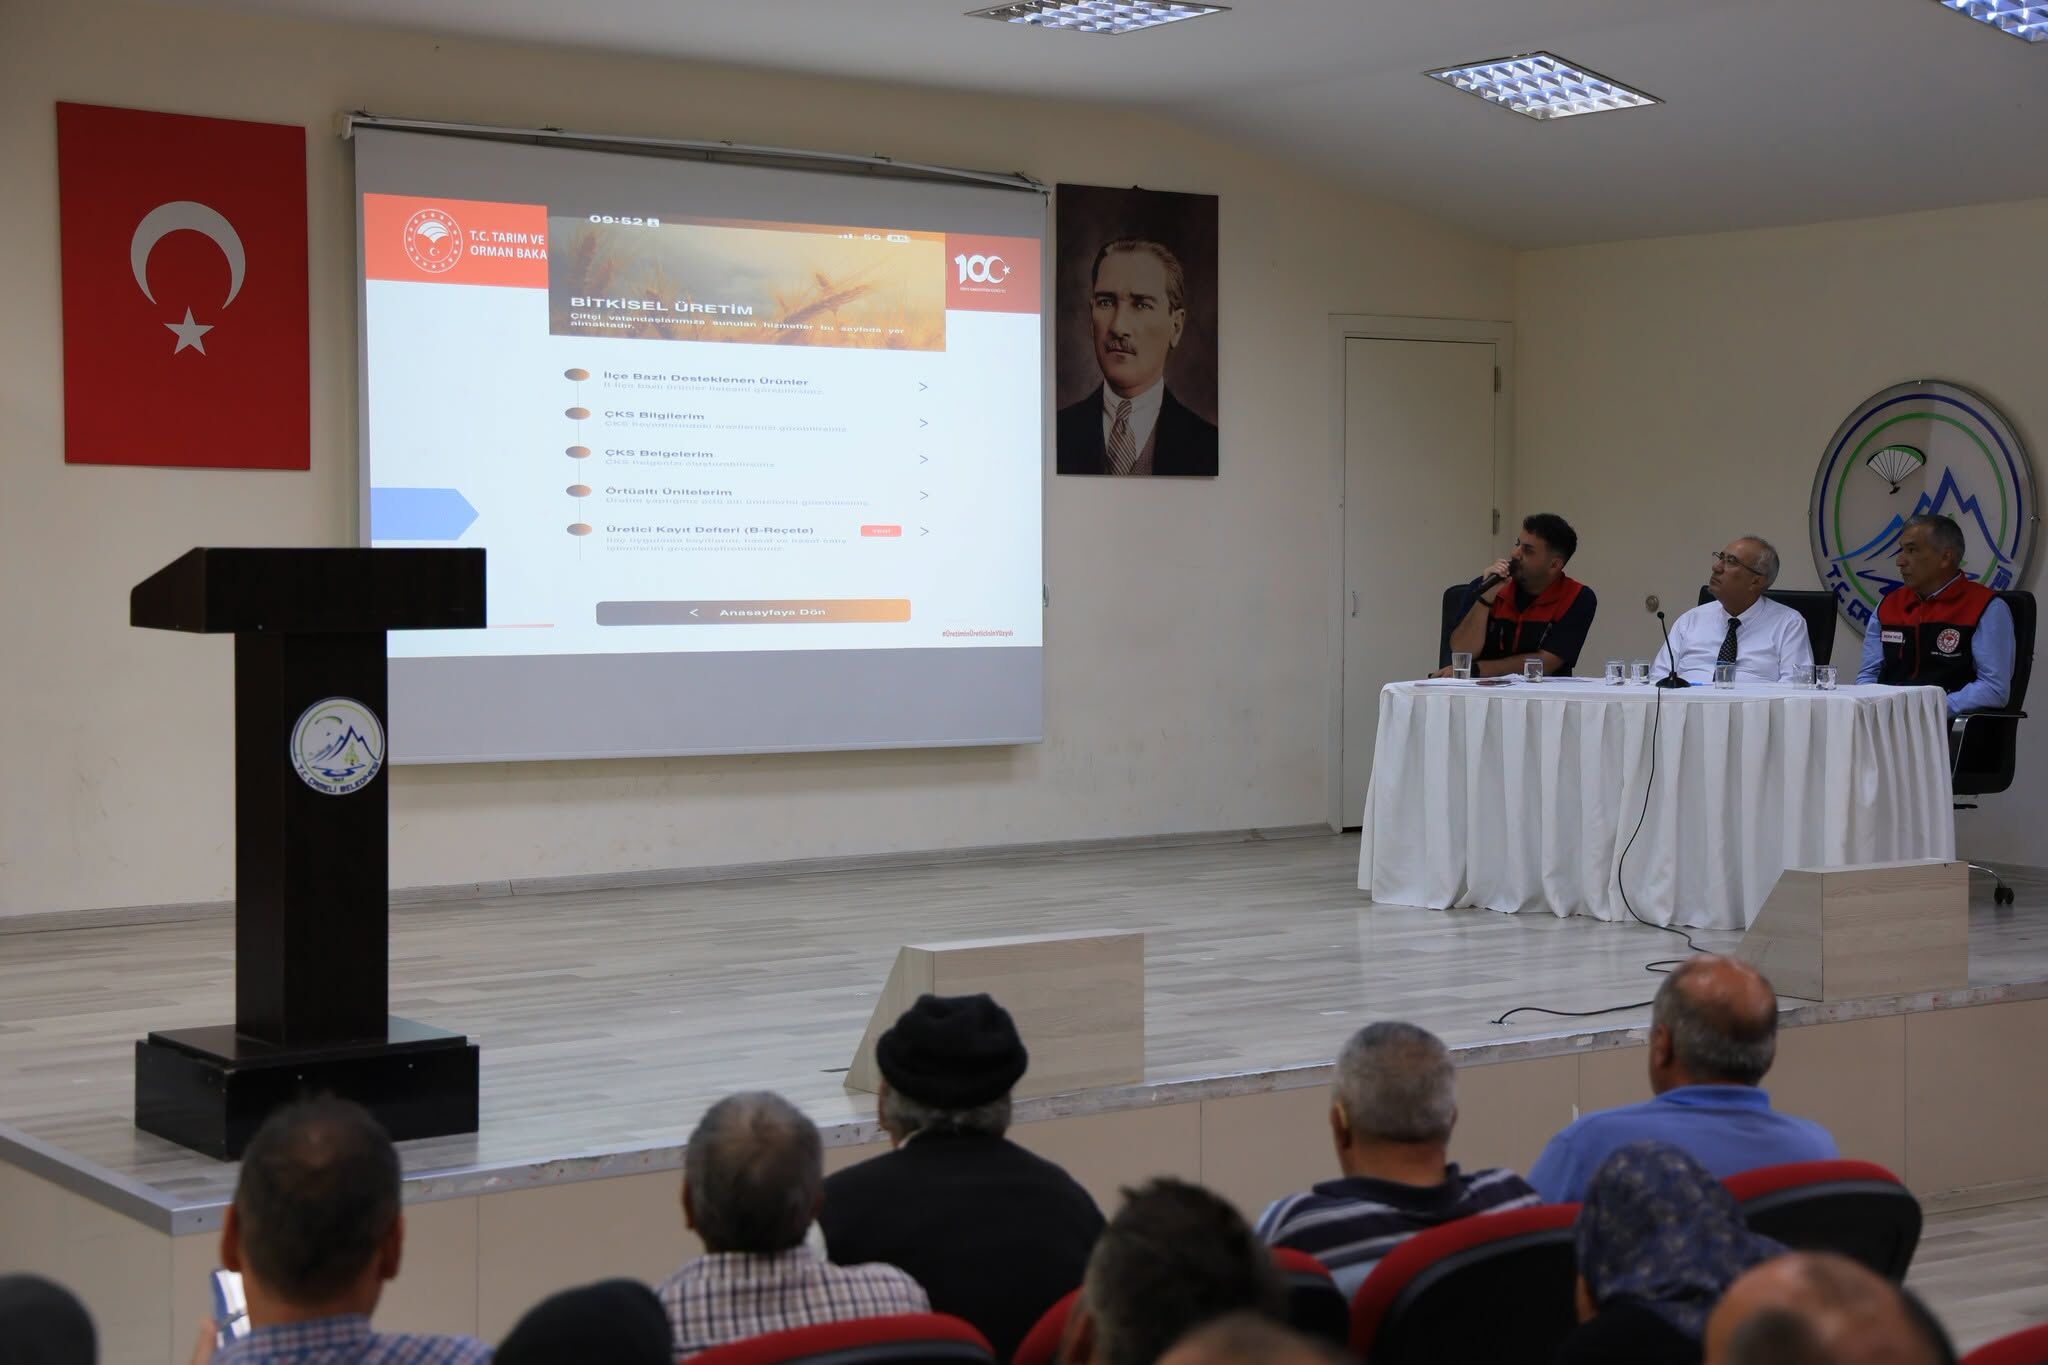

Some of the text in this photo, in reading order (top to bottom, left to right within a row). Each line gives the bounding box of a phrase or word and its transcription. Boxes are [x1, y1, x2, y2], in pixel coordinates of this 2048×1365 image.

[590, 215, 643, 226] 09:52
[469, 230, 545, 245] T.C. TARIM VE
[470, 245, 548, 260] ORMAN BAKA
[571, 295, 753, 315] BİTKİSEL ÜRETİM
[603, 371, 809, 386] İlçe Bazlı Desteklenen Ürünler
[604, 411, 705, 421] ÇKS Bilgilerim
[605, 449, 714, 459] ÇKS Belgelerim
[663, 487, 733, 496] Ünitelerim
[606, 525, 652, 533] Üretici
[656, 527, 690, 535] Kayıt
[695, 526, 740, 534] Defteri
[719, 607, 826, 618] Anasayfaya Dön
